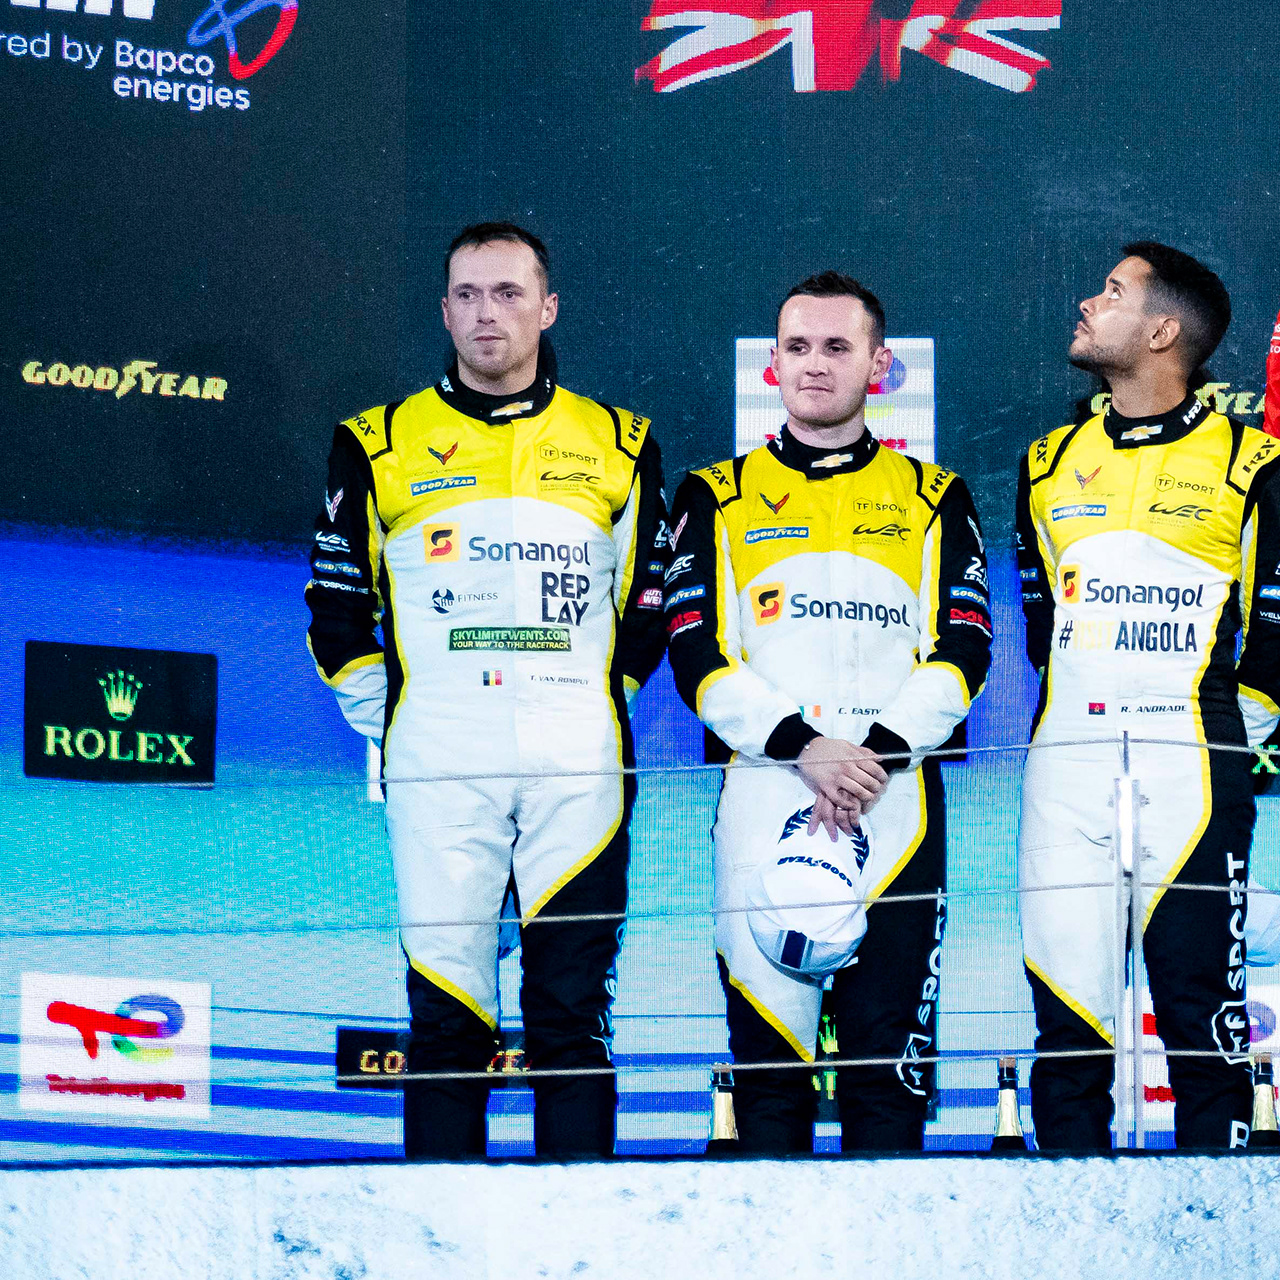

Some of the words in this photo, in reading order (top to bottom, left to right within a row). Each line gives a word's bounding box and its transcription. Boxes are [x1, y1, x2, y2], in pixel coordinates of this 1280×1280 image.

[62, 34, 103, 70] by
[115, 40, 215, 77] Bapco
[113, 74, 250, 112] energies
[22, 359, 228, 401] GOODYEAR
[543, 448, 556, 457] TF
[561, 451, 598, 465] SPORT
[1242, 438, 1276, 473] HRX
[412, 478, 475, 493] GOODYEAR
[540, 471, 601, 485] WEC
[1158, 478, 1172, 487] TF
[1177, 481, 1216, 495] SPORT
[857, 503, 870, 511] TF
[1053, 505, 1105, 518] GOODYEAR
[1148, 502, 1214, 521] WEC
[745, 528, 807, 541] GOODYEAR
[853, 523, 911, 540] WEC
[469, 535, 591, 570] Sonangol
[458, 593, 498, 602] FITNESS
[1085, 577, 1204, 613] Sonangol
[541, 597, 590, 626] LAY
[790, 593, 911, 629] Sonangol
[1115, 620, 1197, 652] ANGOLA
[526, 641, 569, 649] RACETRACK
[838, 707, 848, 715] C.
[1121, 705, 1132, 713] R.
[1136, 705, 1187, 713] ANDRADE
[43, 725, 196, 768] ROLEX
